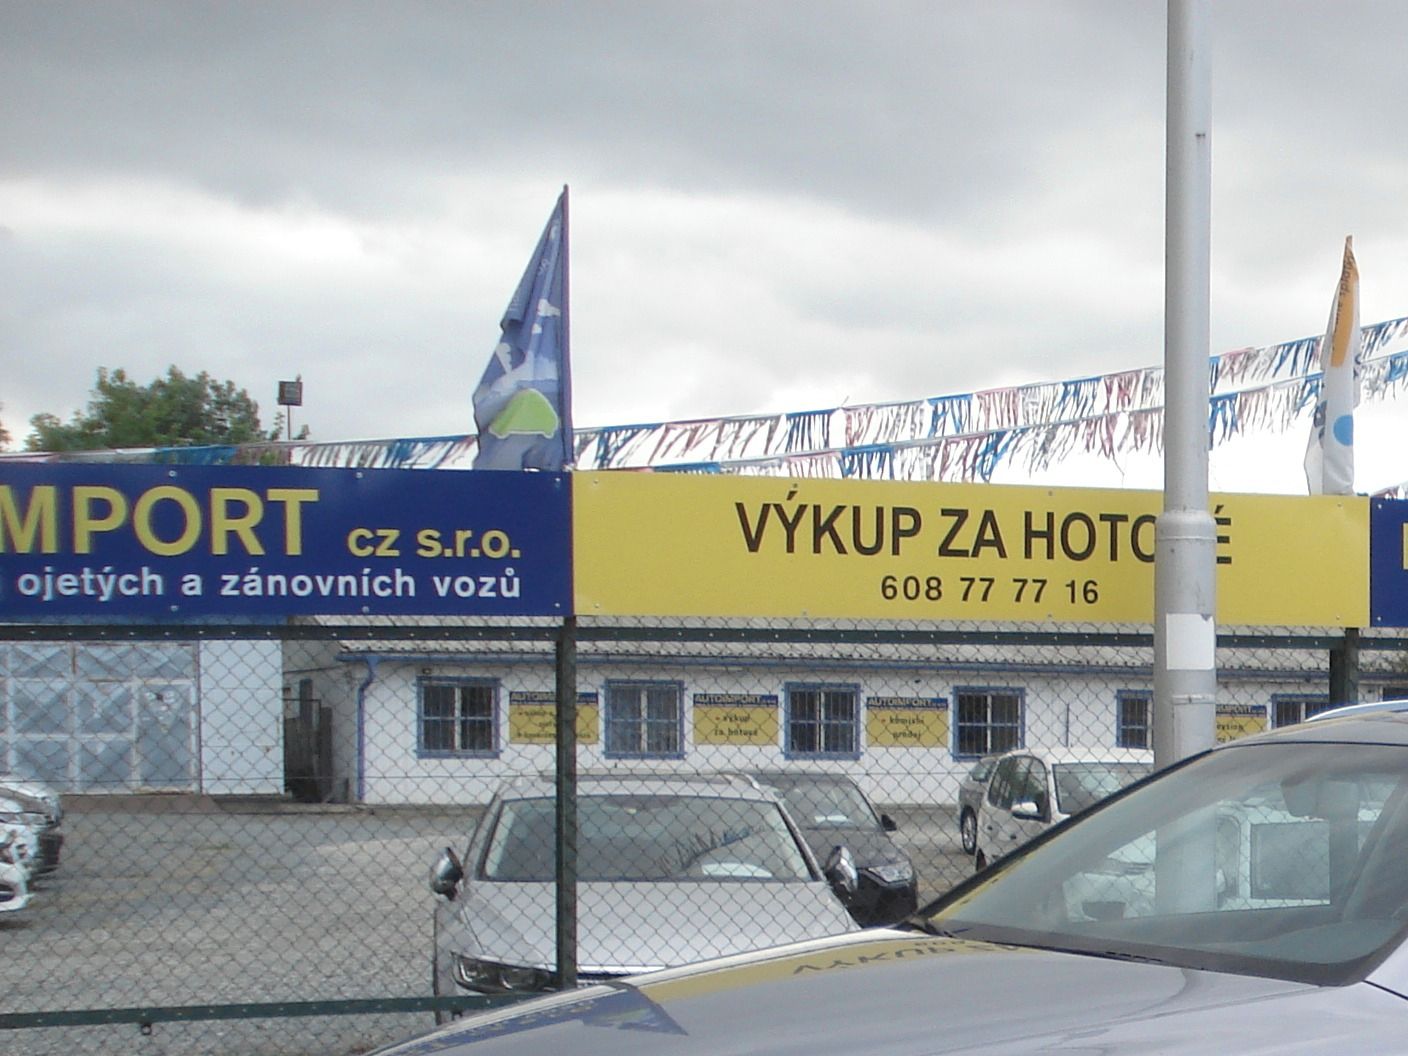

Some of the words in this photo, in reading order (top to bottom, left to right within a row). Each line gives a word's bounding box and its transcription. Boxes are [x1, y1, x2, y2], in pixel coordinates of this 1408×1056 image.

[347, 528, 400, 558] cz
[417, 529, 521, 559] s.r.o.
[735, 490, 922, 557] VÝKUP
[938, 508, 1008, 559] ZA
[1023, 504, 1233, 565] HOTOÉ
[17, 566, 164, 602] ojetých
[181, 573, 202, 597] a
[220, 567, 416, 598] zánovních
[433, 568, 521, 599] vozů
[880, 575, 943, 601] 608
[959, 577, 996, 603] 77
[1012, 578, 1048, 604] 77
[1065, 579, 1100, 605] 16
